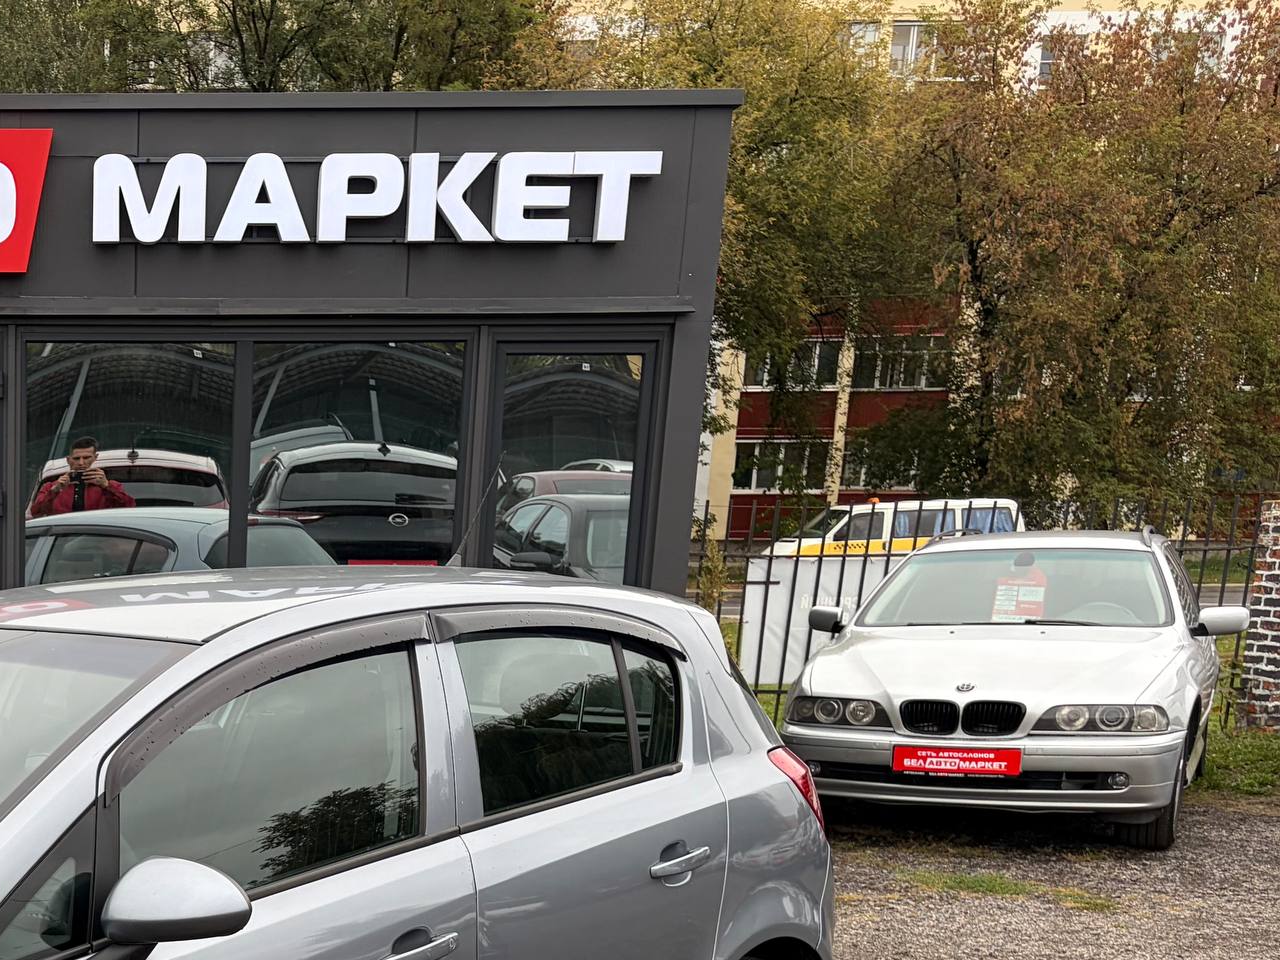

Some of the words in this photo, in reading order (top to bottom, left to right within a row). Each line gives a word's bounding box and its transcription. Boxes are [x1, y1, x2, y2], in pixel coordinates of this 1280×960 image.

[92, 150, 663, 243] МАРКЕТ
[904, 758, 926, 767] БЕЛ
[927, 759, 958, 768] АВТО
[960, 760, 1007, 769] МАРКЕТ
